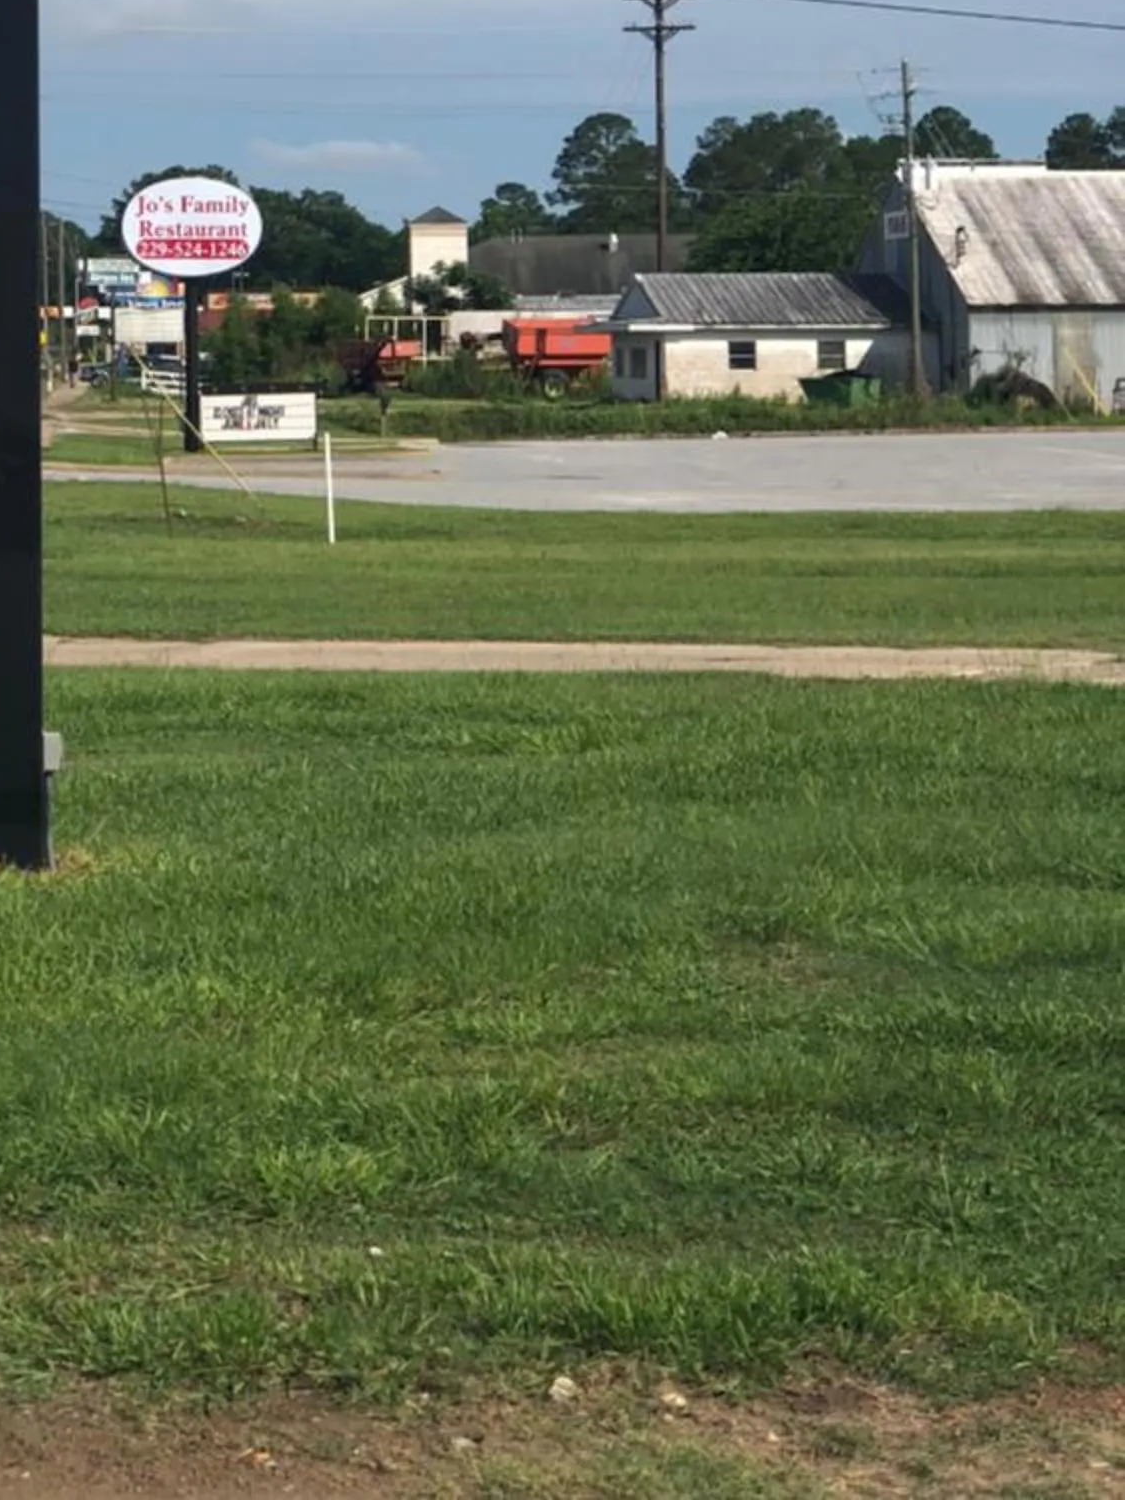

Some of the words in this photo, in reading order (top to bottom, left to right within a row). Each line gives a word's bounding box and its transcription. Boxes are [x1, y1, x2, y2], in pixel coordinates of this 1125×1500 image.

[136, 196, 174, 216] Jo's
[180, 195, 249, 216] Family
[139, 220, 248, 237] Restaurant
